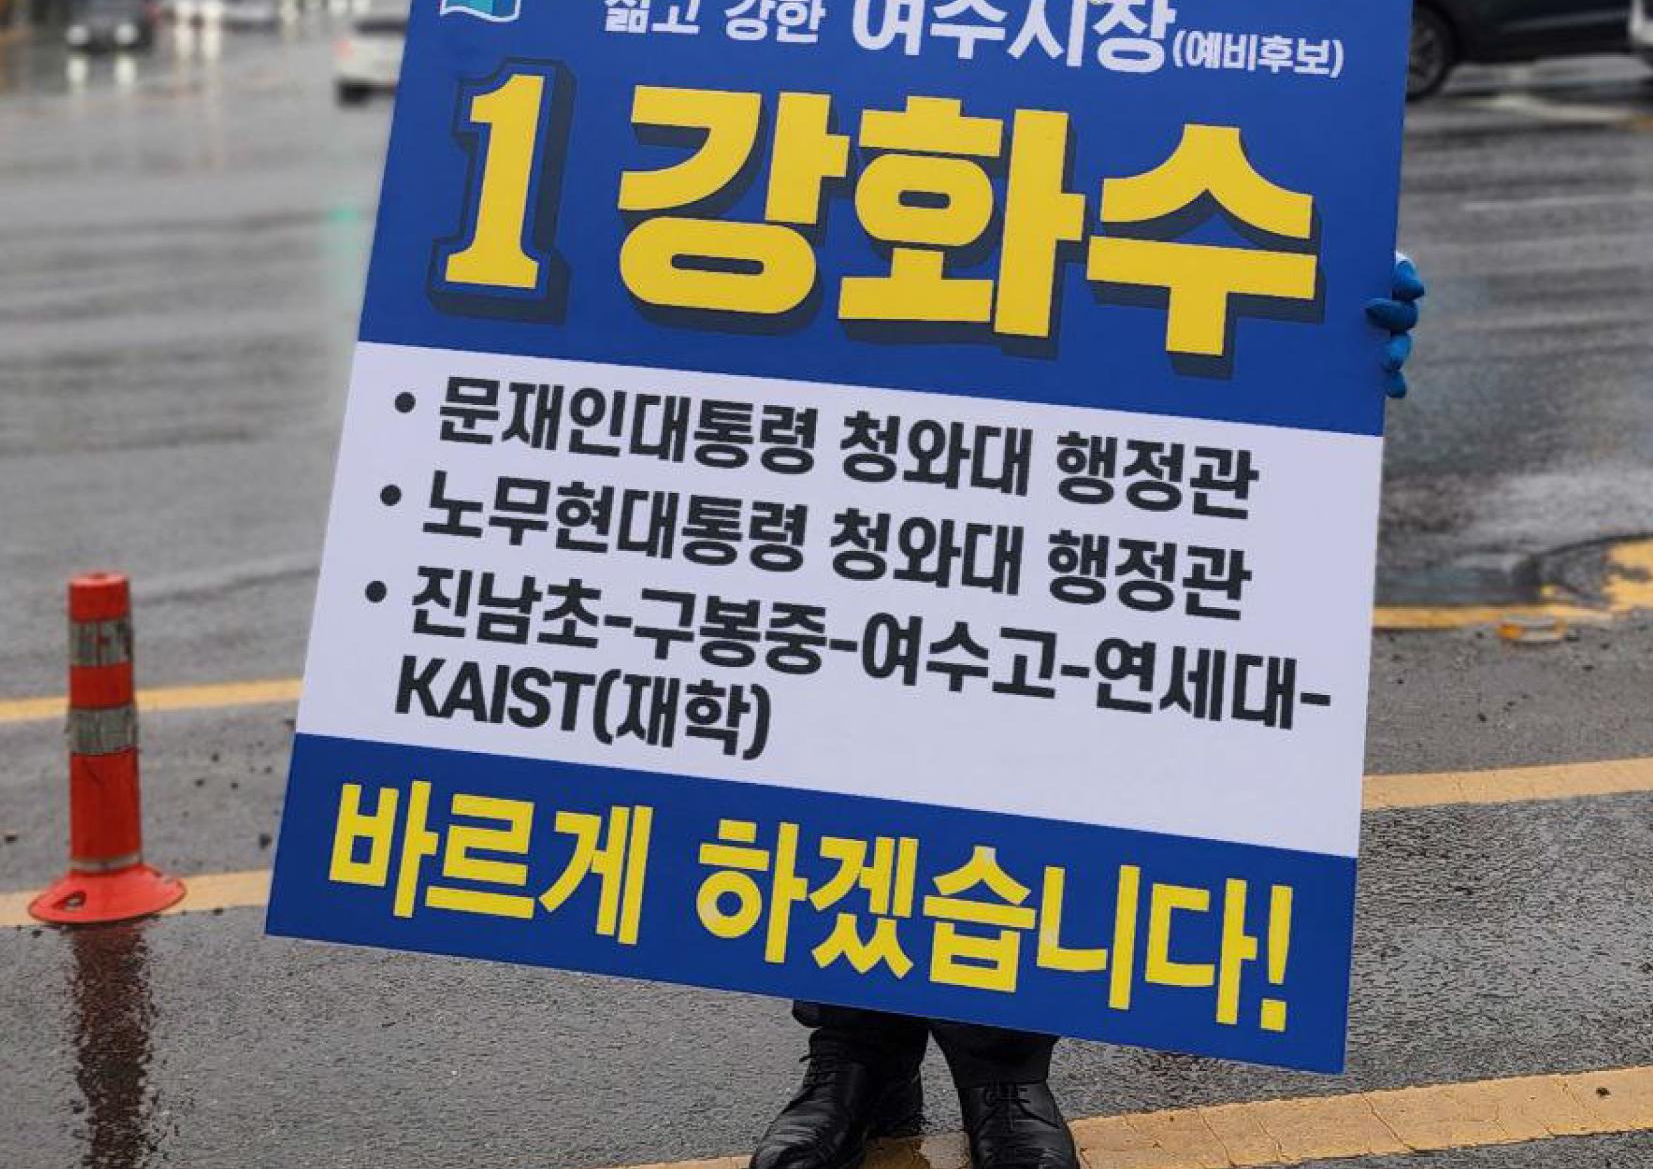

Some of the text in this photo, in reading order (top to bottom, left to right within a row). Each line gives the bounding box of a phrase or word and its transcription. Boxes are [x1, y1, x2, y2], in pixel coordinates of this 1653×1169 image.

[1172, 29, 1344, 78] (예비후보)
[446, 73, 545, 289] 1
[618, 84, 1319, 357] 강화수
[438, 376, 1261, 521] 문재인대통령 청와대 행정관
[421, 469, 1254, 622] 노무현대통령 청와대 행정관
[393, 654, 772, 762] KAIST(재학)
[410, 564, 1332, 731] 진남초-구봉중-여수고-연세대-
[330, 780, 1293, 1031] 바르게 하겠습니다!
